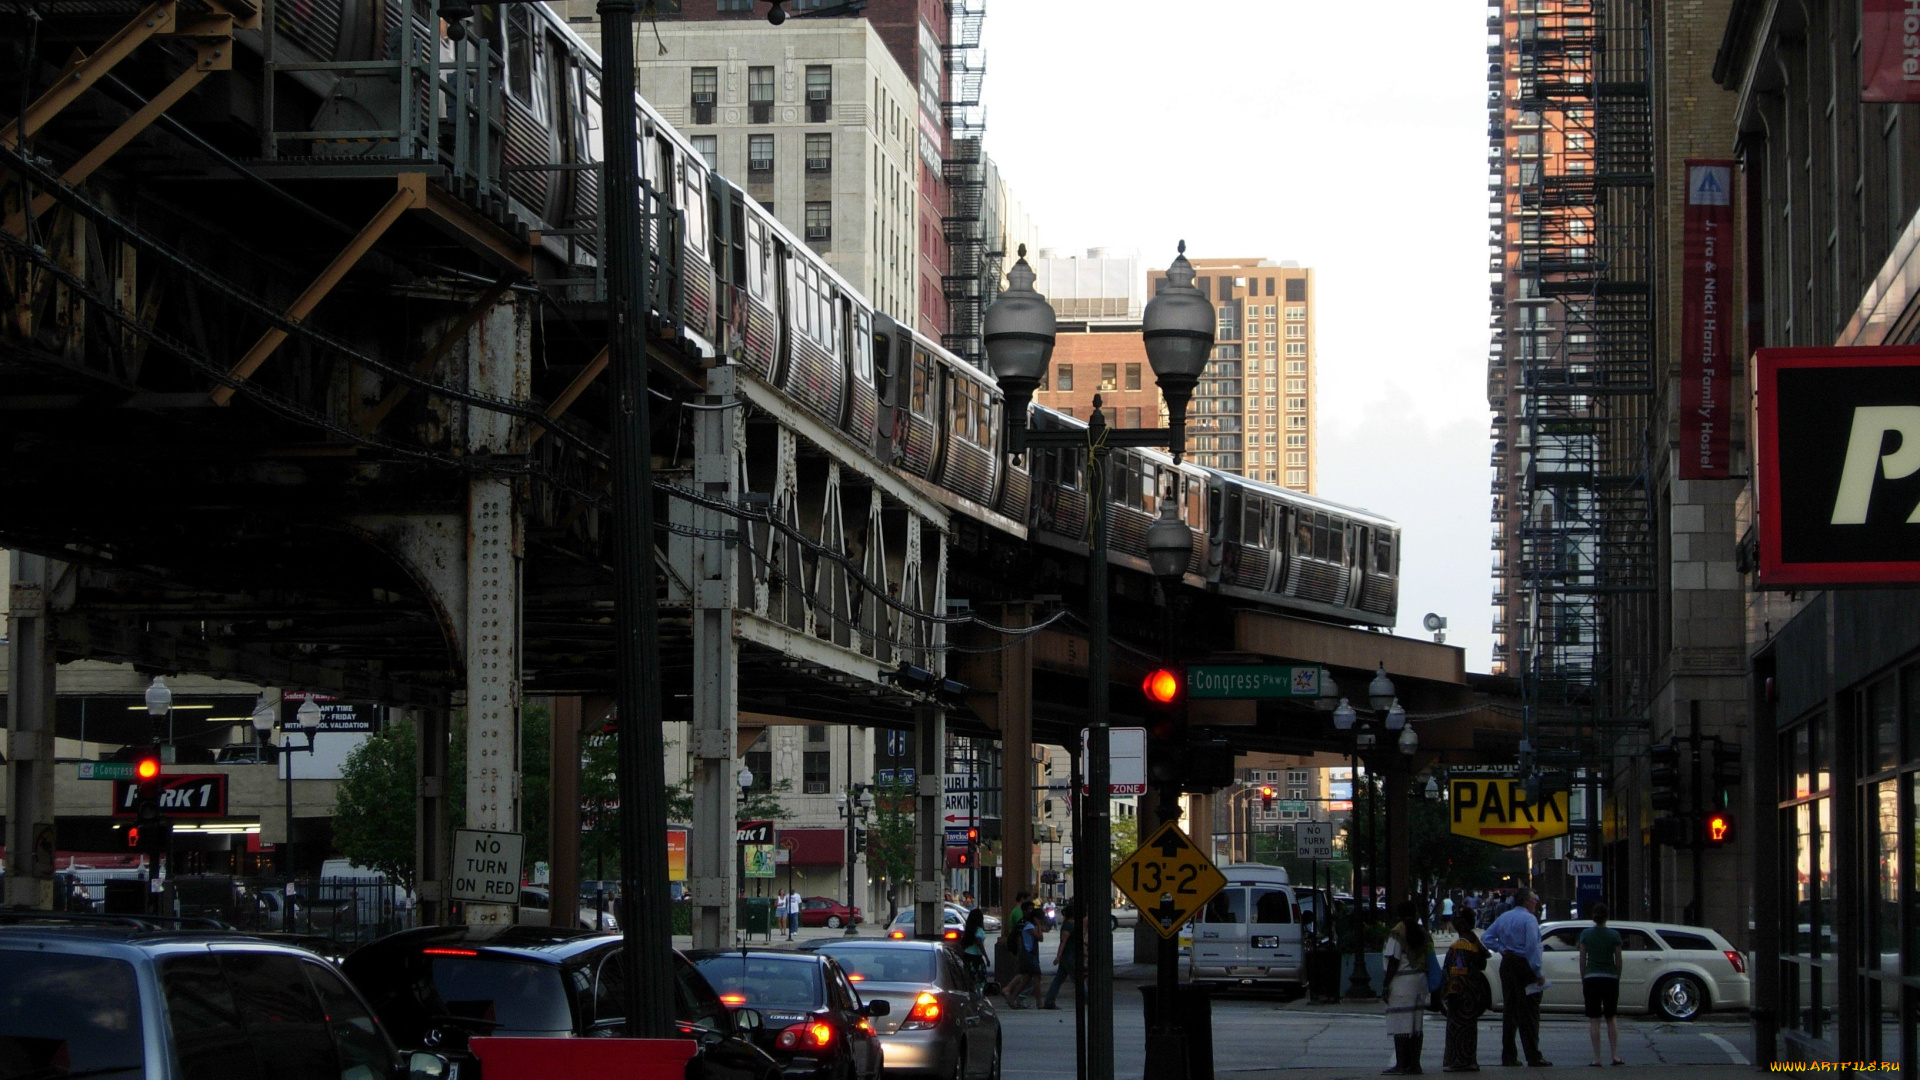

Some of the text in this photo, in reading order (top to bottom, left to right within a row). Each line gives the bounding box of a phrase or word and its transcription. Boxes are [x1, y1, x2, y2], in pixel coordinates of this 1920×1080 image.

[1902, 0, 1920, 81] Hostel
[1705, 219, 1717, 231] J.
[1705, 261, 1717, 272] &
[1704, 277, 1717, 314] Nicki
[1703, 319, 1717, 364] Harris
[1698, 368, 1715, 418] Family
[1700, 422, 1714, 469] Hostel
[1830, 405, 1920, 525] P
[1187, 670, 1288, 695] E Congress Pkwy
[99, 765, 133, 778] Congress
[200, 784, 212, 807] 1
[1113, 784, 1140, 794] ZONE
[1453, 781, 1563, 822] PARK
[759, 827, 767, 841] 1
[1307, 826, 1321, 835] NO
[475, 840, 501, 854] NO
[1304, 837, 1325, 845] TURN
[467, 858, 507, 874] TURN
[1573, 864, 1594, 874] ATM
[456, 878, 514, 895] ON RED
[1131, 861, 1208, 895] 13'-2"
